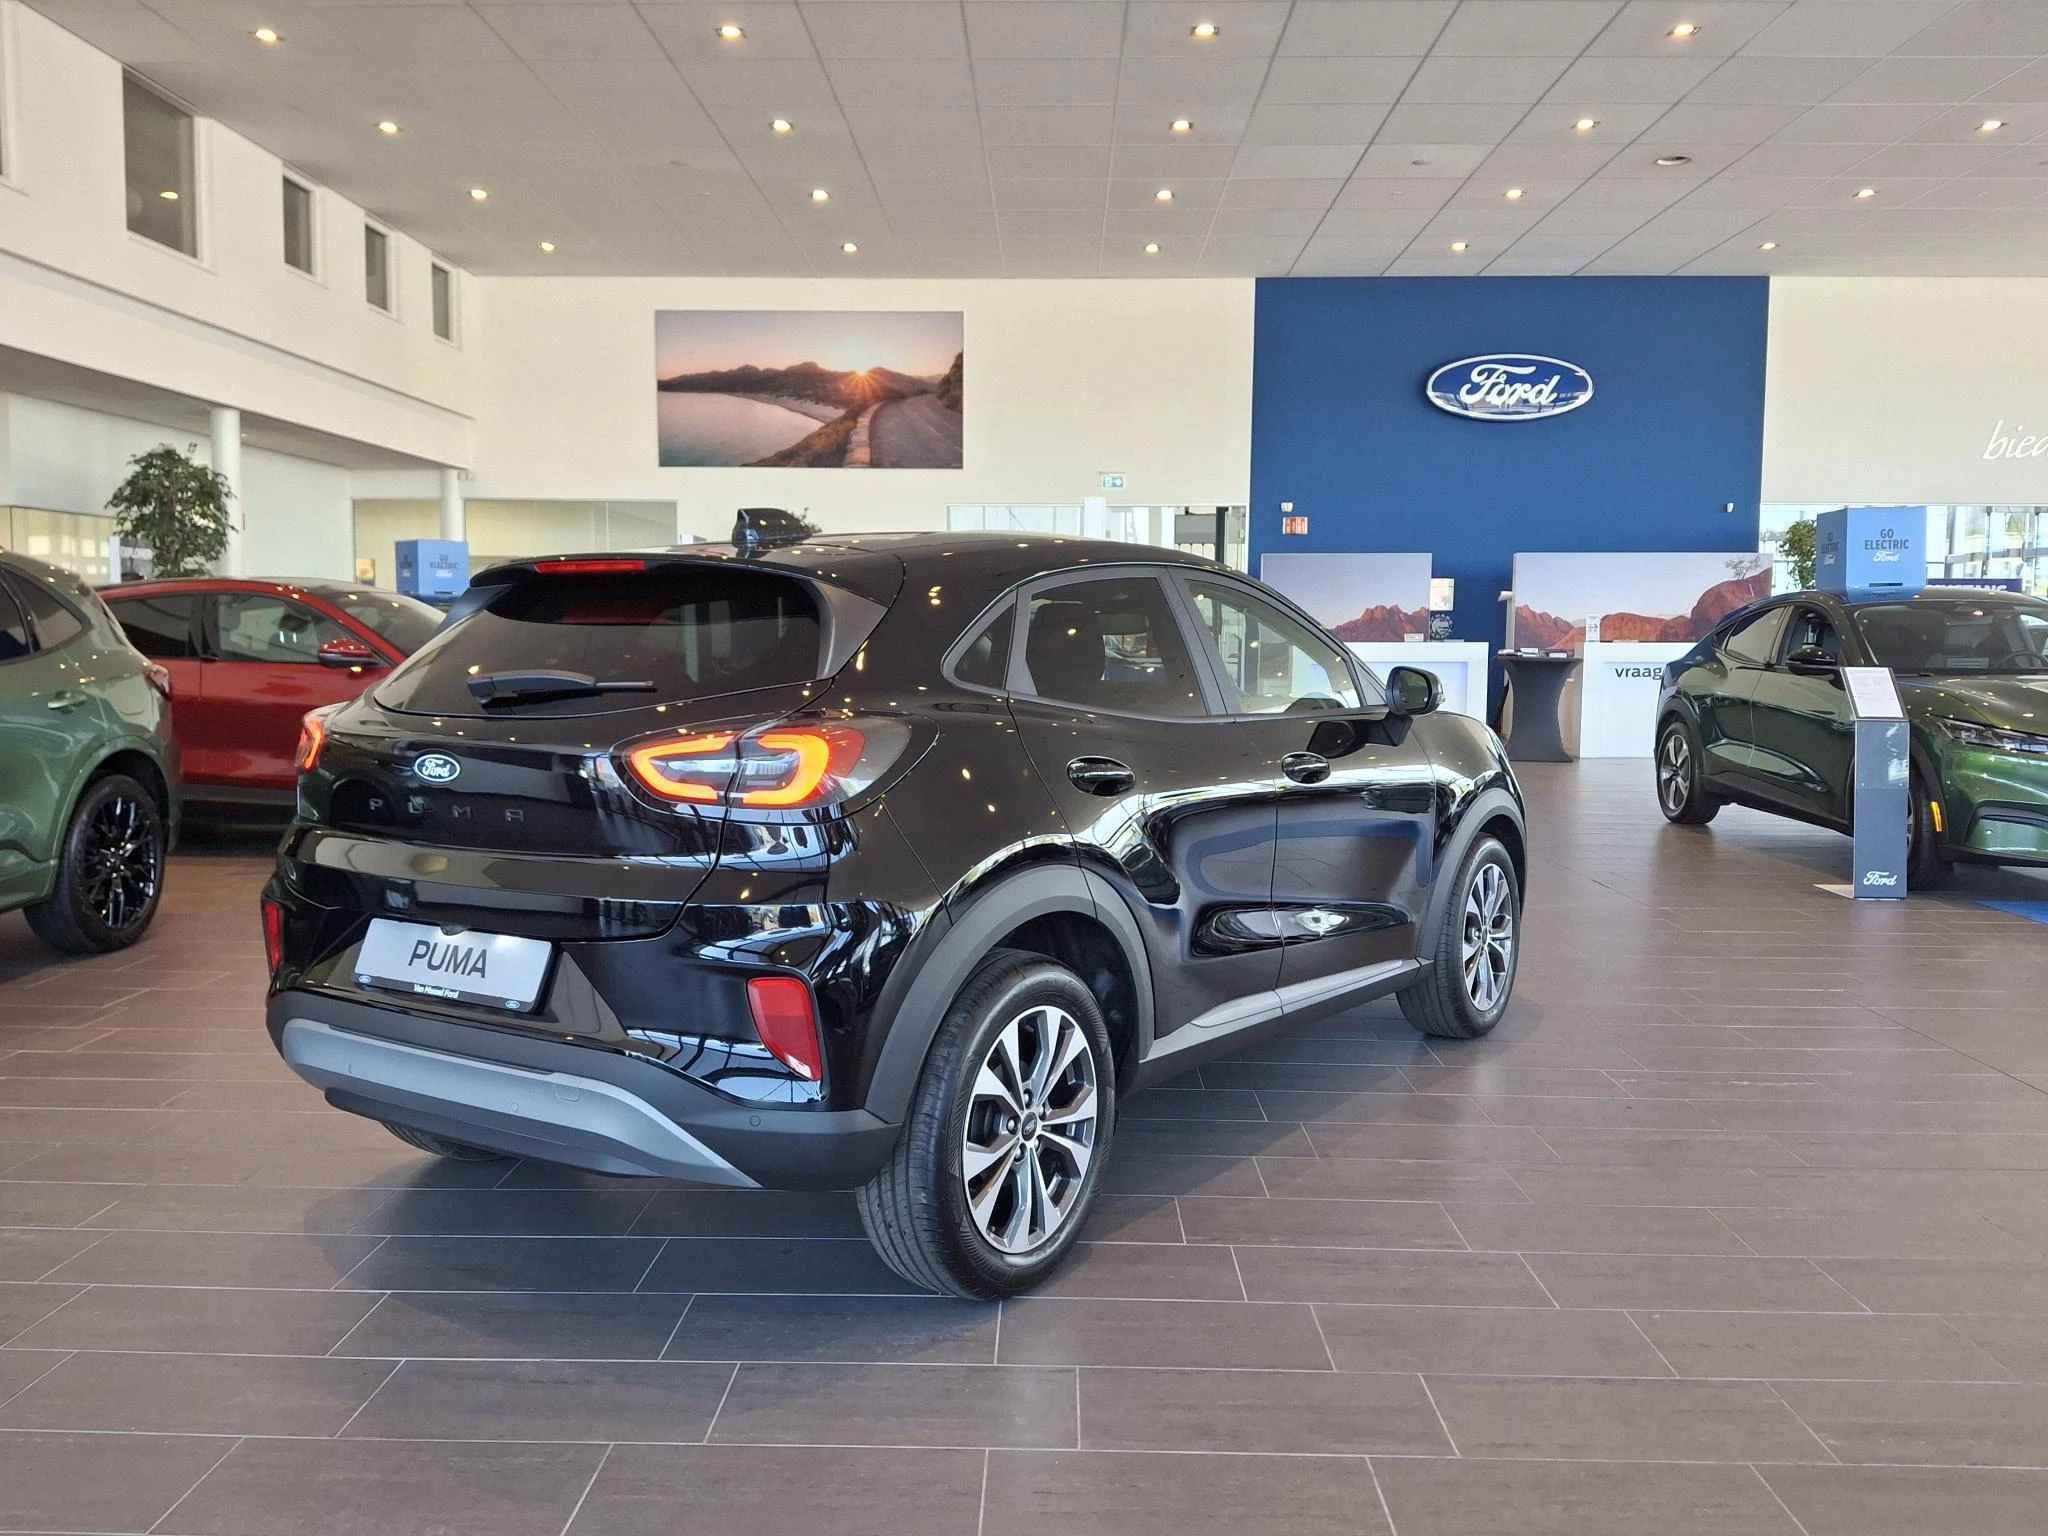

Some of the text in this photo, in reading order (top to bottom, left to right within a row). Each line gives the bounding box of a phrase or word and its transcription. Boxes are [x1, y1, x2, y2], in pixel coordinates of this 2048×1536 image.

[1459, 363, 1561, 405] Ford
[1880, 528, 1894, 539] GO
[1864, 539, 1910, 550] ELECTRIC
[1873, 551, 1901, 562] Ford
[1615, 666, 1663, 680] vraag
[421, 757, 451, 778] Ford
[368, 795, 525, 823] PUMA
[1862, 869, 1897, 887] Ford
[408, 940, 487, 979] PUMA
[445, 989, 460, 999] Ford
